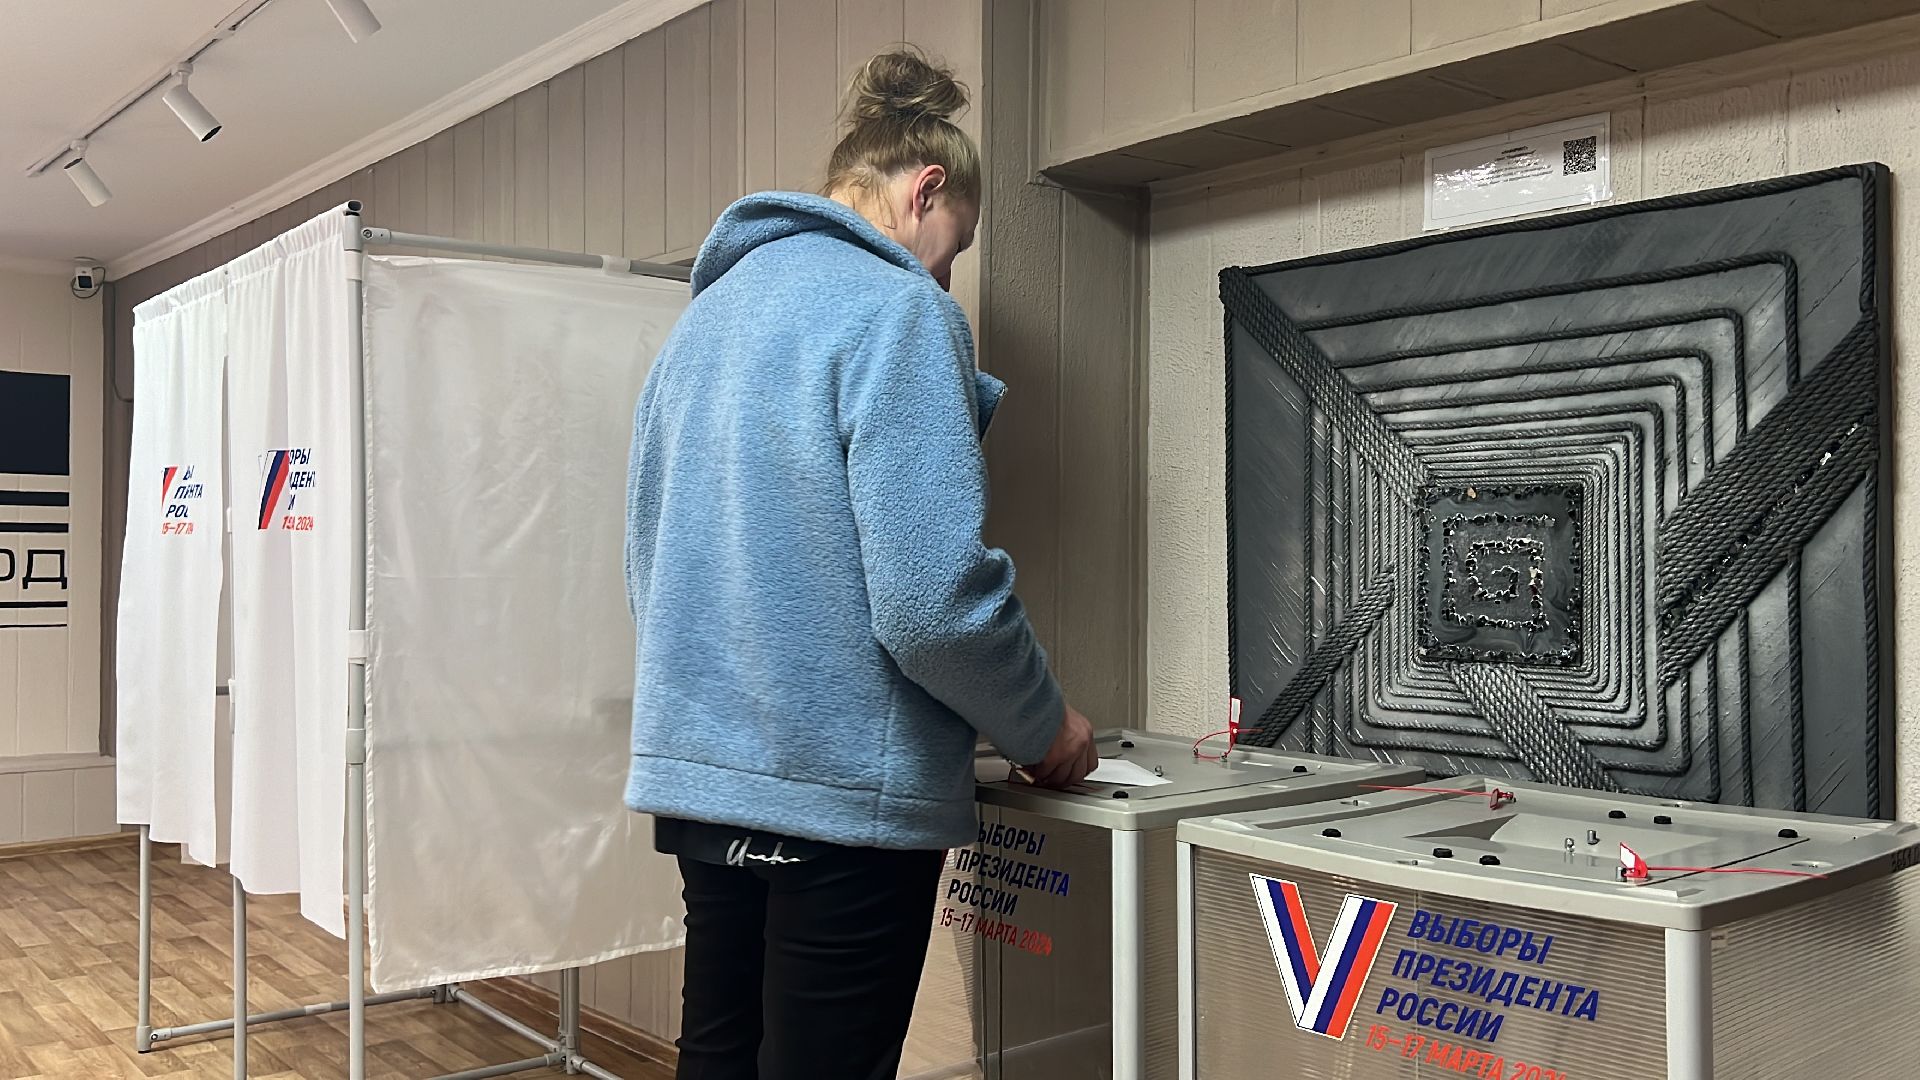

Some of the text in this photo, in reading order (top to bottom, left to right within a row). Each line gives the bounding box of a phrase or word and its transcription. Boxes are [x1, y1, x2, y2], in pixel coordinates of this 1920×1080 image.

[977, 821, 1045, 856] ЫБОРЫ
[955, 848, 1070, 897] ПРЕЗИДЕНТА
[947, 878, 1018, 916] РОССИИ
[974, 916, 1018, 946] МАРТА
[1406, 909, 1554, 965] ВЫБОРЫ
[1391, 949, 1600, 1022] ПРЕЗИДЕНТА
[1376, 988, 1505, 1043] РОССИИ
[1423, 1039, 1504, 1080] МАРТА
[1508, 1060, 1568, 1080] 20
